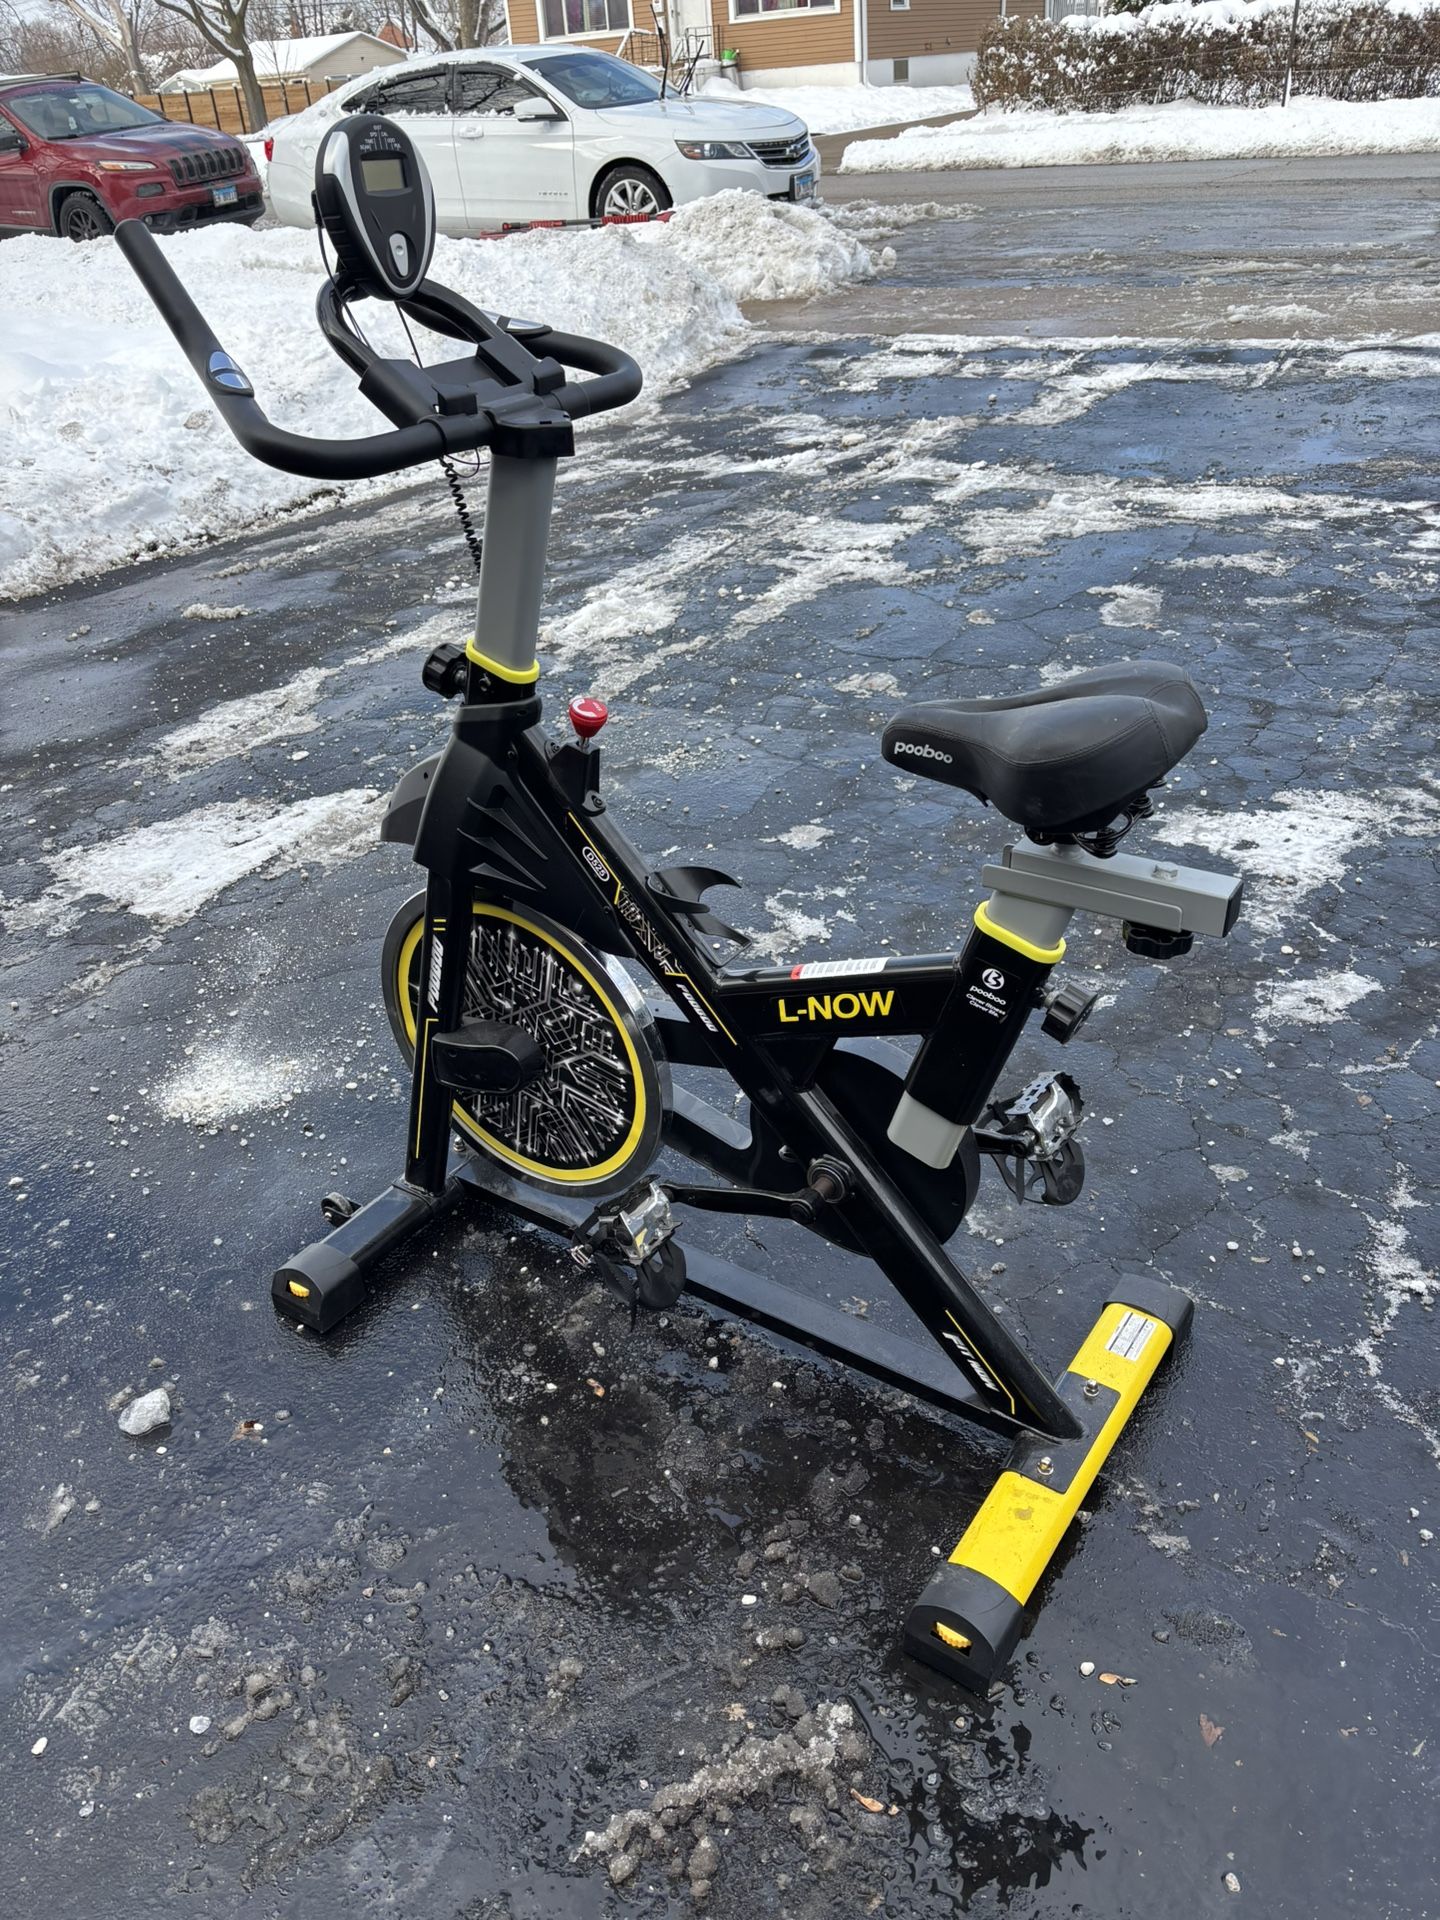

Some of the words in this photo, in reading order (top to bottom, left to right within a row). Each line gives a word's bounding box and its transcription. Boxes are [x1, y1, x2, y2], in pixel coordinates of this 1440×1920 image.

[894, 741, 953, 764] pooboo
[586, 852, 606, 877] D525
[778, 990, 895, 1022] L-NOW
[970, 985, 1006, 1005] pooboo
